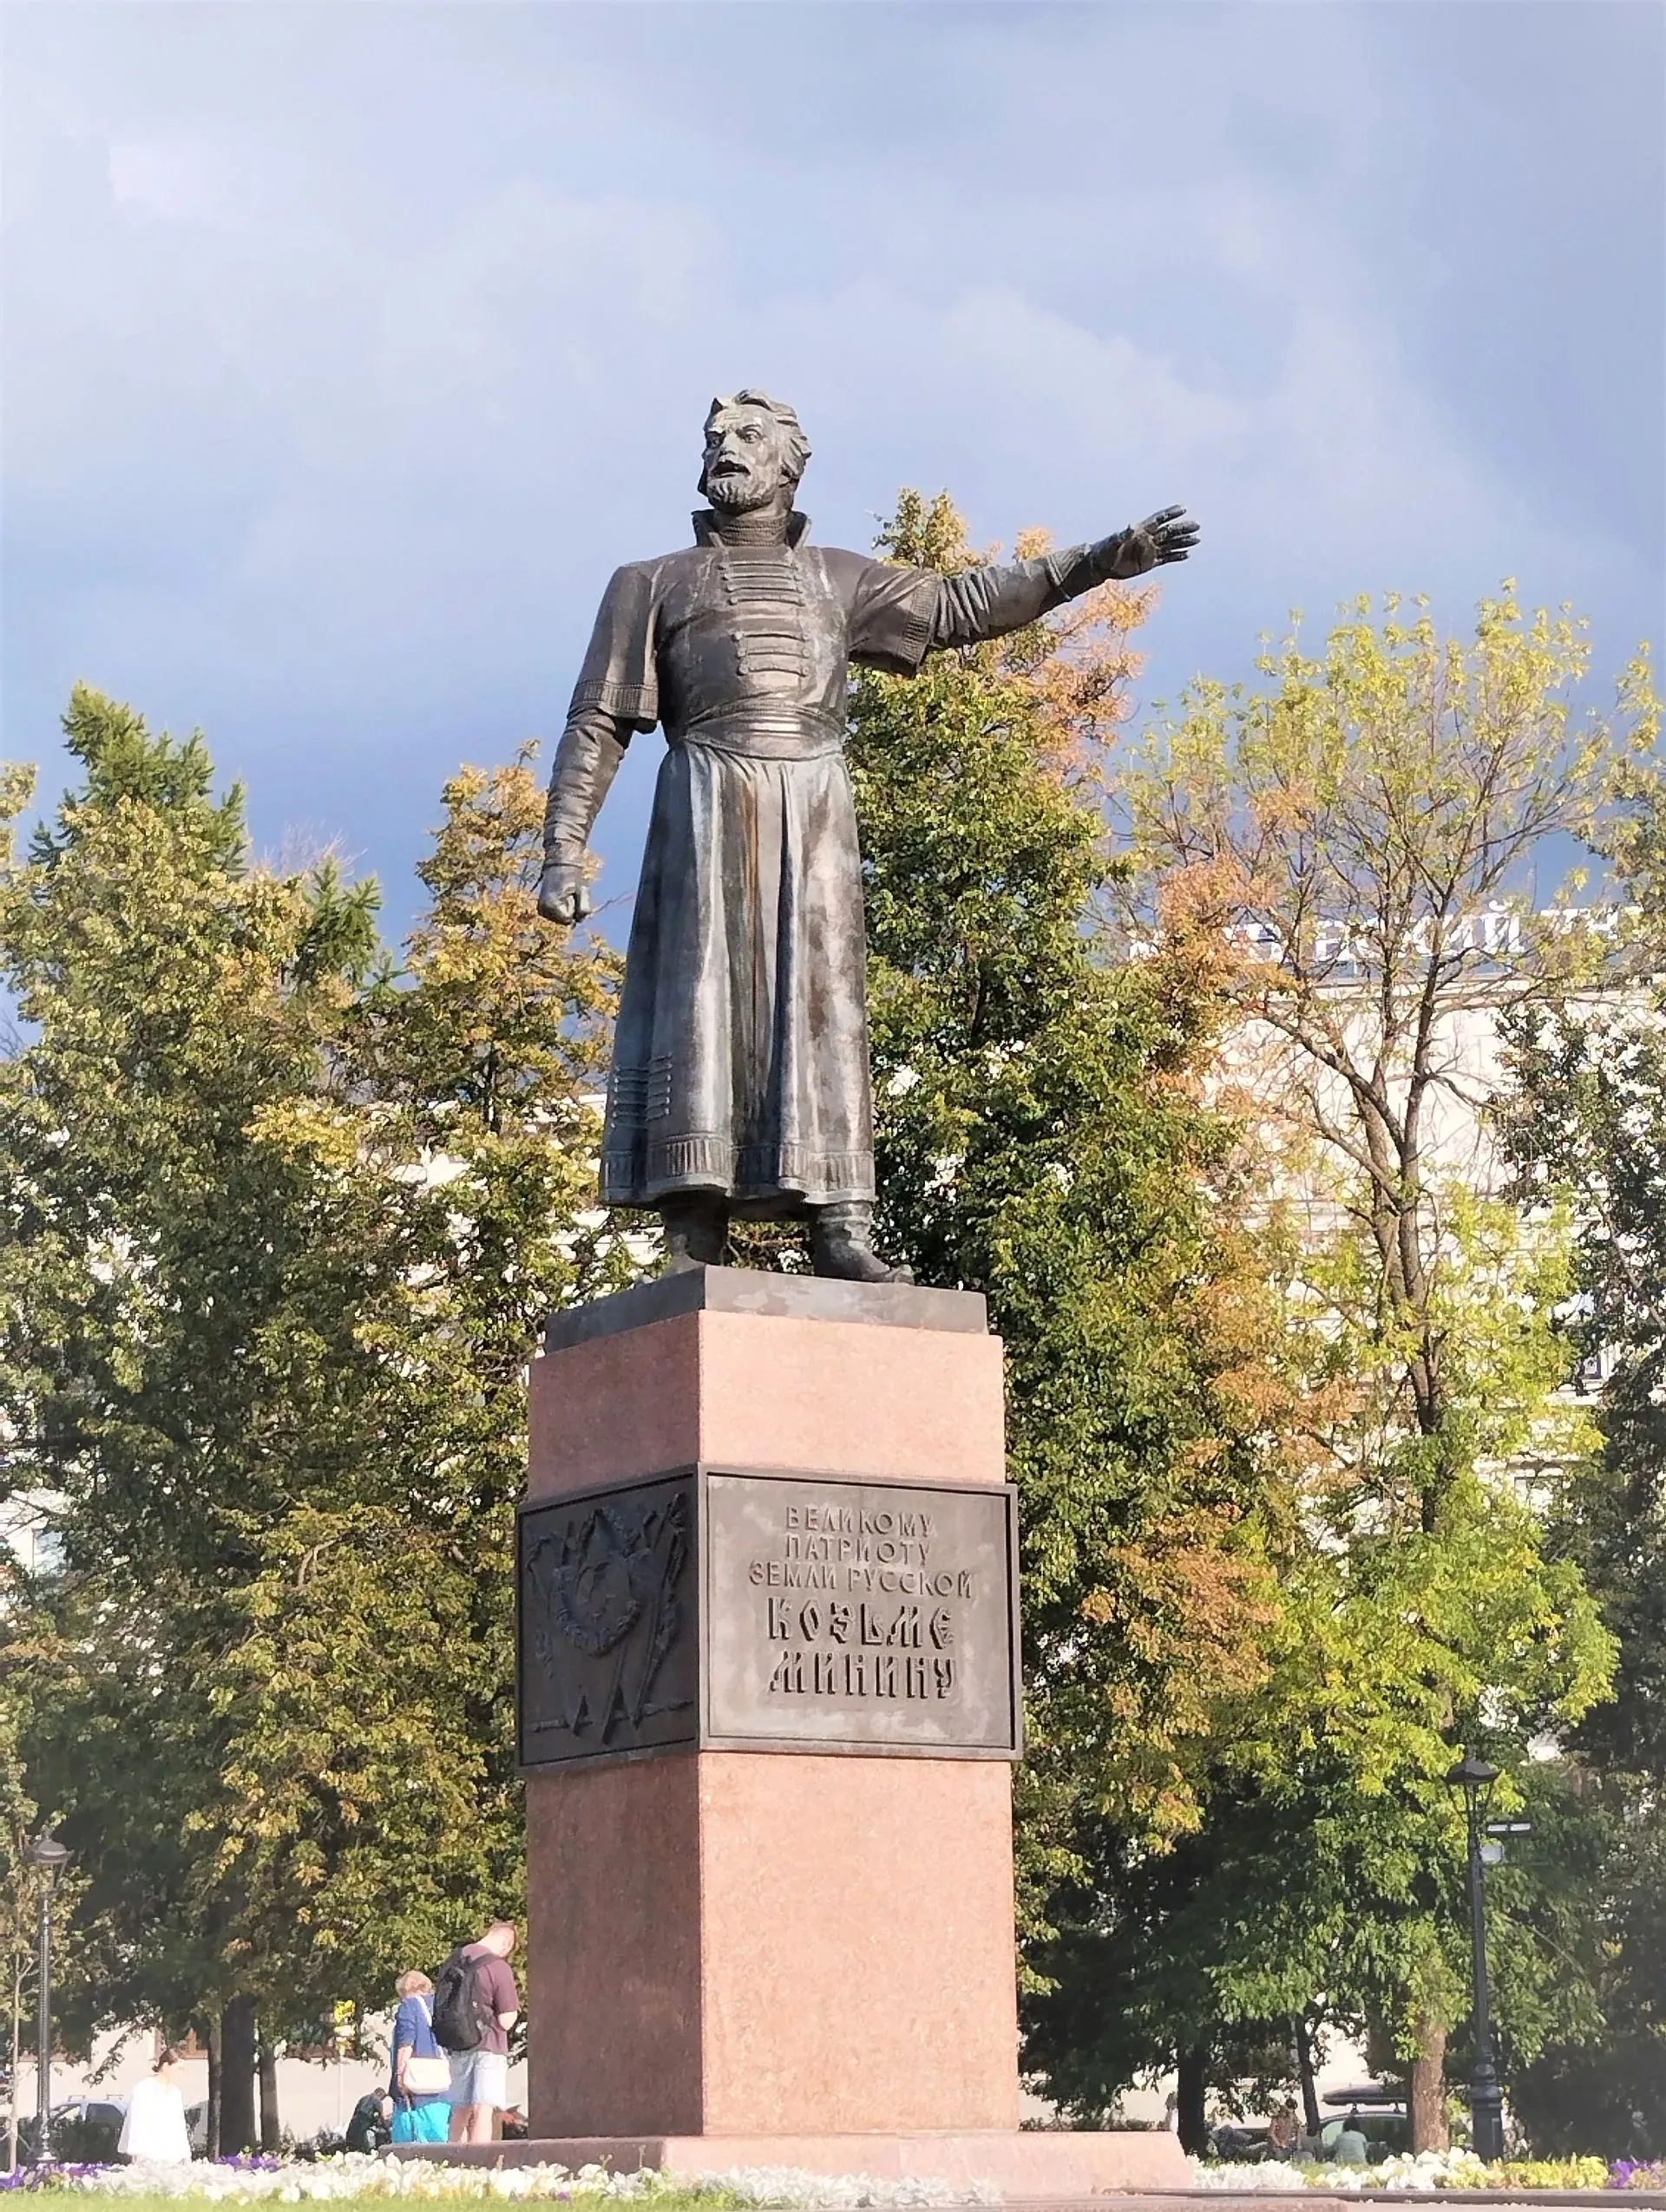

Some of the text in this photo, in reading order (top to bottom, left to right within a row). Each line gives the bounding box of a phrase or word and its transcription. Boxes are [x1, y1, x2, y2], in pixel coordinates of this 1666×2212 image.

[785, 1506, 933, 1538] ВЕЛИКОМУ
[785, 1533, 931, 1566] ПАТРИОТУ
[749, 1561, 972, 1599] ЗЕМЛИ РУССКОЙ
[767, 1596, 954, 1650] КОЗЬМЕ
[769, 1651, 955, 1699] МИНИНУ
